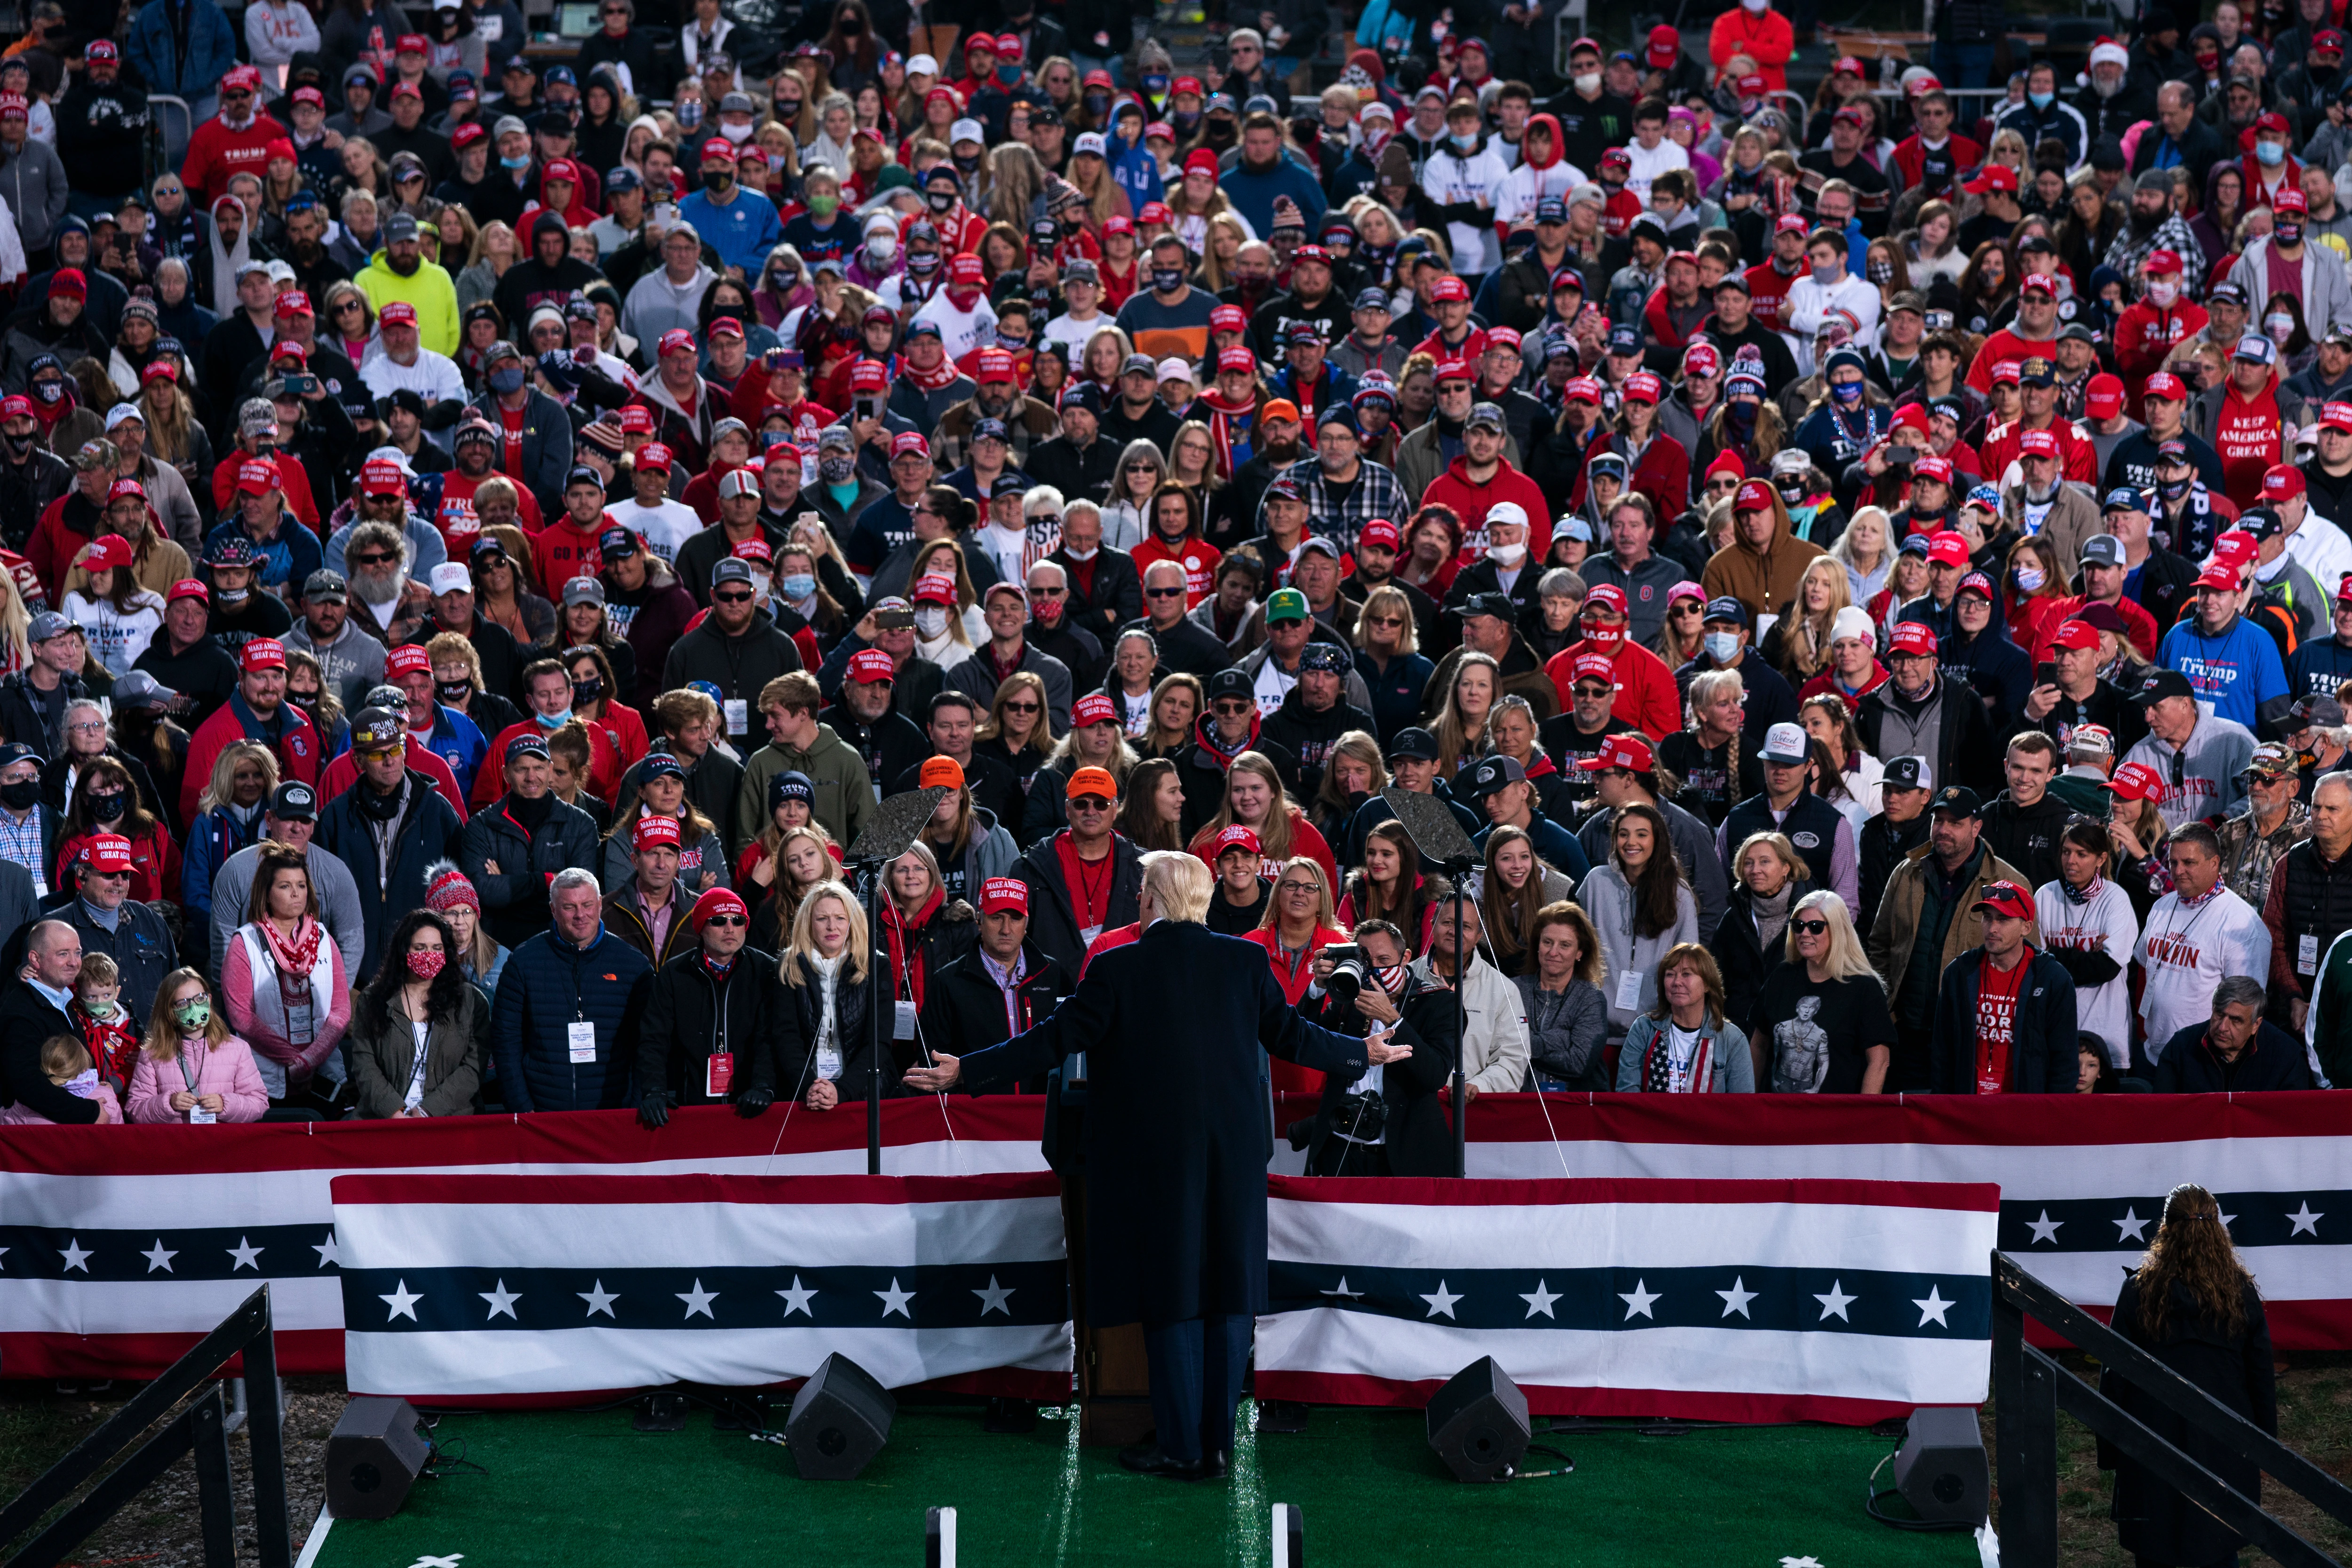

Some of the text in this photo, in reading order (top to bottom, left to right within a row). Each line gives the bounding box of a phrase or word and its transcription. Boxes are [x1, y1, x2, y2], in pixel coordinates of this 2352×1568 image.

[224, 147, 266, 158] TRUMP
[2027, 274, 2051, 290] USA
[2213, 284, 2239, 294] TRUMP
[1728, 382, 1755, 395] 2020
[2233, 415, 2267, 430] KEEP
[2032, 432, 2054, 442] AMERICA
[2218, 428, 2278, 443] AMERICA
[2021, 440, 2050, 449] GREAT AGAIN
[2226, 444, 2268, 458] GREAT
[380, 467, 400, 475] AMERICA
[2126, 464, 2154, 476] TRU
[449, 516, 481, 533] 202
[1027, 521, 1059, 545] USA
[2217, 539, 2240, 549] Trump
[554, 547, 570, 559] GO
[916, 577, 949, 587] MAKE AMERICA
[917, 585, 931, 594] GREAT
[1589, 589, 1619, 599] TRUMP
[88, 628, 135, 637] RUMP
[1902, 625, 1926, 636] AMERICA
[1907, 635, 1922, 643] AGAIN
[247, 644, 263, 653] MAKE
[251, 652, 282, 661] GREAT AGAIN
[390, 649, 426, 661] MAKE AMERICA
[858, 653, 893, 664] MAKE AMERICA
[394, 656, 426, 669] GREAT AGAIN
[861, 662, 879, 670] GREAT
[1575, 655, 1613, 668] MAKE AMERICA
[1577, 662, 1609, 674] GREAT AGAIN
[2180, 656, 2237, 684] Trump
[2191, 676, 2219, 690] 2020
[2309, 672, 2343, 686] TRU
[1078, 697, 1113, 710] MAKE AMERICA
[1081, 708, 1098, 717] GREAT
[369, 718, 395, 733] TRUMP
[376, 726, 398, 740] 2020
[1772, 733, 1799, 744] Wetzel
[2090, 732, 2109, 753] STATES
[2253, 748, 2282, 758] TRUMP
[1575, 771, 1592, 780] 2020
[2124, 765, 2147, 782] AMERICA
[2125, 775, 2140, 788] AGAIN
[640, 819, 679, 831] MAKE AMERICA
[644, 828, 677, 838] GREAT AGAIN
[1221, 829, 1250, 839] AMERICA
[96, 841, 114, 850] MAKE
[80, 848, 89, 860] 45
[100, 851, 119, 860] GREAT
[679, 846, 702, 870] ATE
[986, 881, 1027, 892] MAKE AMERICA
[989, 891, 1024, 901] GREAT AGAIN
[2059, 927, 2083, 937] JUDGE
[2167, 931, 2187, 944] JUDGE
[2147, 937, 2200, 969] WILKIN
